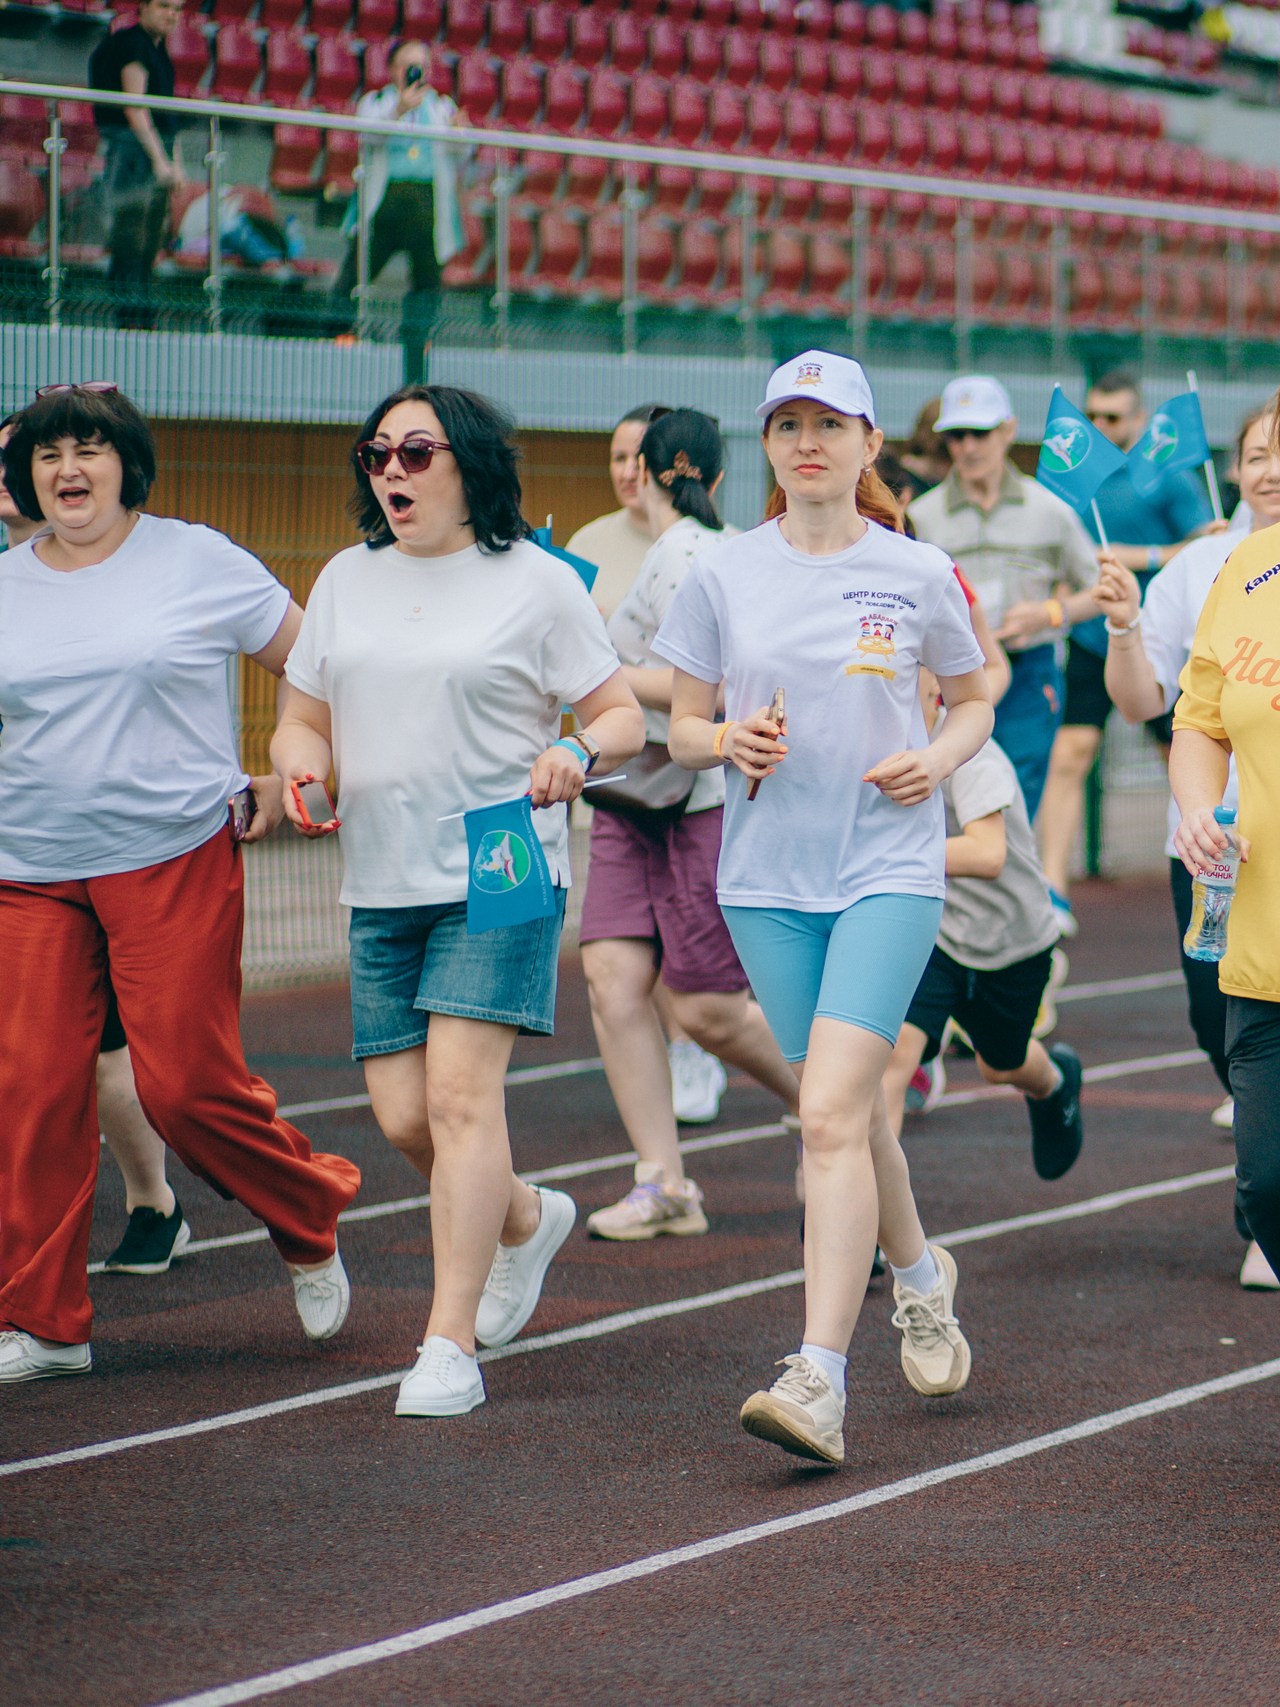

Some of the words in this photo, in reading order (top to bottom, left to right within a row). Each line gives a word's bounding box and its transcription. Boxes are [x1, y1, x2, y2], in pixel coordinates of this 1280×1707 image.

[842, 591, 869, 600] ЦЕНТР
[871, 591, 917, 611] КОРРЕКЦИИ
[1212, 864, 1231, 872] ТОЙ
[1199, 869, 1232, 879] СТОЧНИК
